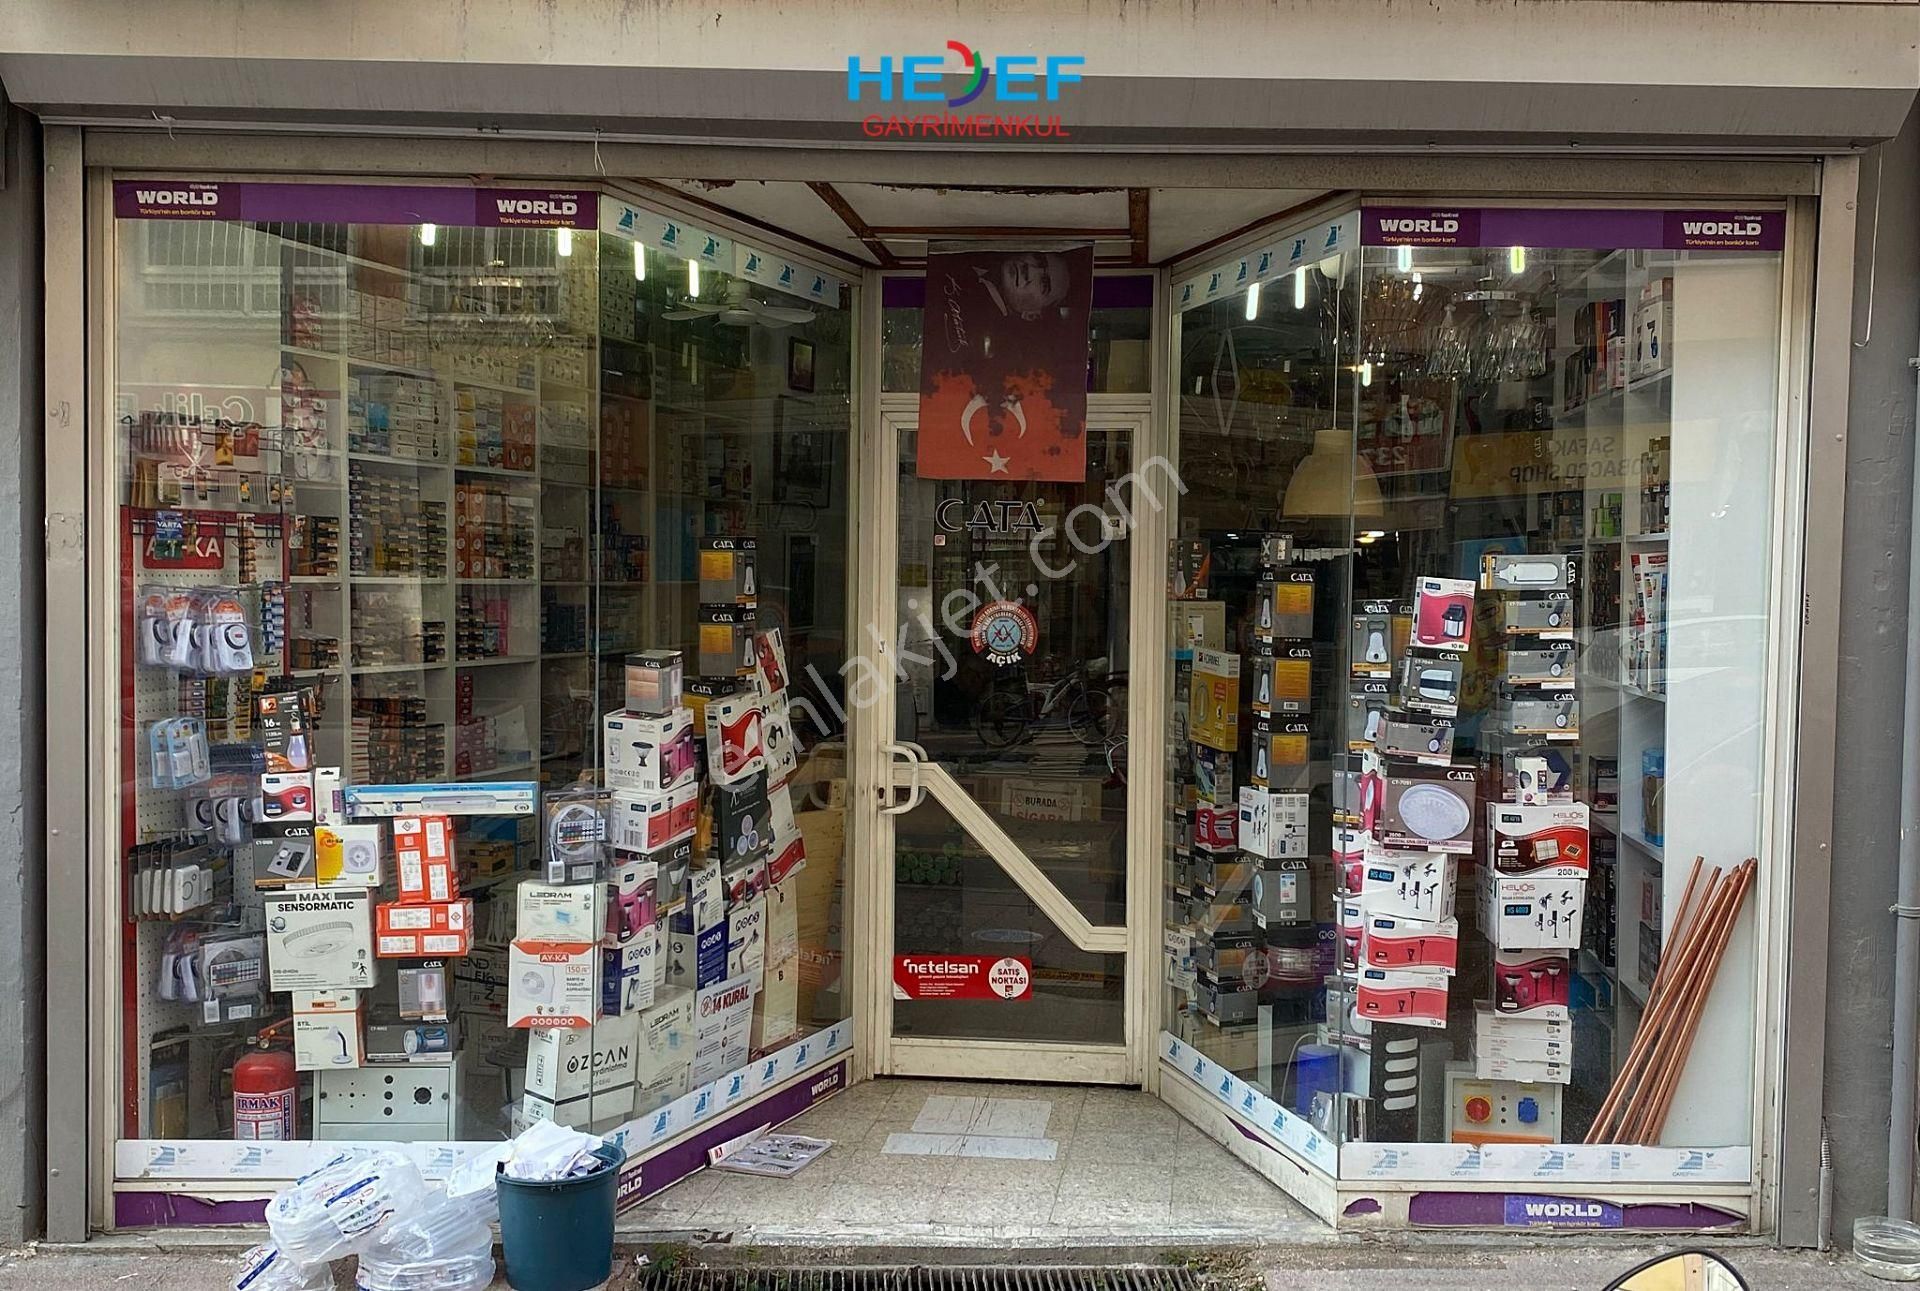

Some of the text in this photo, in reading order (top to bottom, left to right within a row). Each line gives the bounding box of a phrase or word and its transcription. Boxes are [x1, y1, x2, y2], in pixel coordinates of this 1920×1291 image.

[136, 190, 218, 206] WORLD
[496, 199, 578, 215] WORLD
[1380, 219, 1459, 233] WORLD
[1683, 222, 1762, 236] WORLD
[157, 521, 183, 530] VARTA
[713, 540, 735, 549] CATA
[1567, 561, 1576, 584] CATA
[1291, 573, 1314, 582] CATA
[1548, 592, 1570, 600] CATA
[1366, 604, 1389, 613] CATA
[711, 613, 734, 622] CATA
[1289, 648, 1312, 657] CATA
[1438, 652, 1460, 661] CATA
[985, 652, 1022, 667] AÇIK
[691, 684, 713, 694] CATA
[1364, 683, 1388, 693] CATA
[1554, 693, 1575, 701] CATA
[263, 719, 275, 728] 16
[1431, 718, 1452, 727] CATA
[1285, 723, 1309, 733] CATA
[1527, 739, 1549, 747] CATA
[1446, 770, 1476, 782] CATA
[1025, 796, 1057, 808] BURADA
[1552, 811, 1584, 819] HELIOS
[285, 828, 310, 837] CATA
[1280, 860, 1308, 871] CATA
[1501, 884, 1536, 892] HELIOS
[278, 901, 354, 912] SENSORMATIC
[903, 959, 979, 974] netelsan
[997, 968, 1020, 977] SATIŞ
[991, 976, 1027, 985] NOKTASI
[712, 996, 722, 1014] 14
[722, 985, 751, 1009] KURAL
[811, 1074, 839, 1096] WORLD
[1525, 1203, 1603, 1217] WORLD
